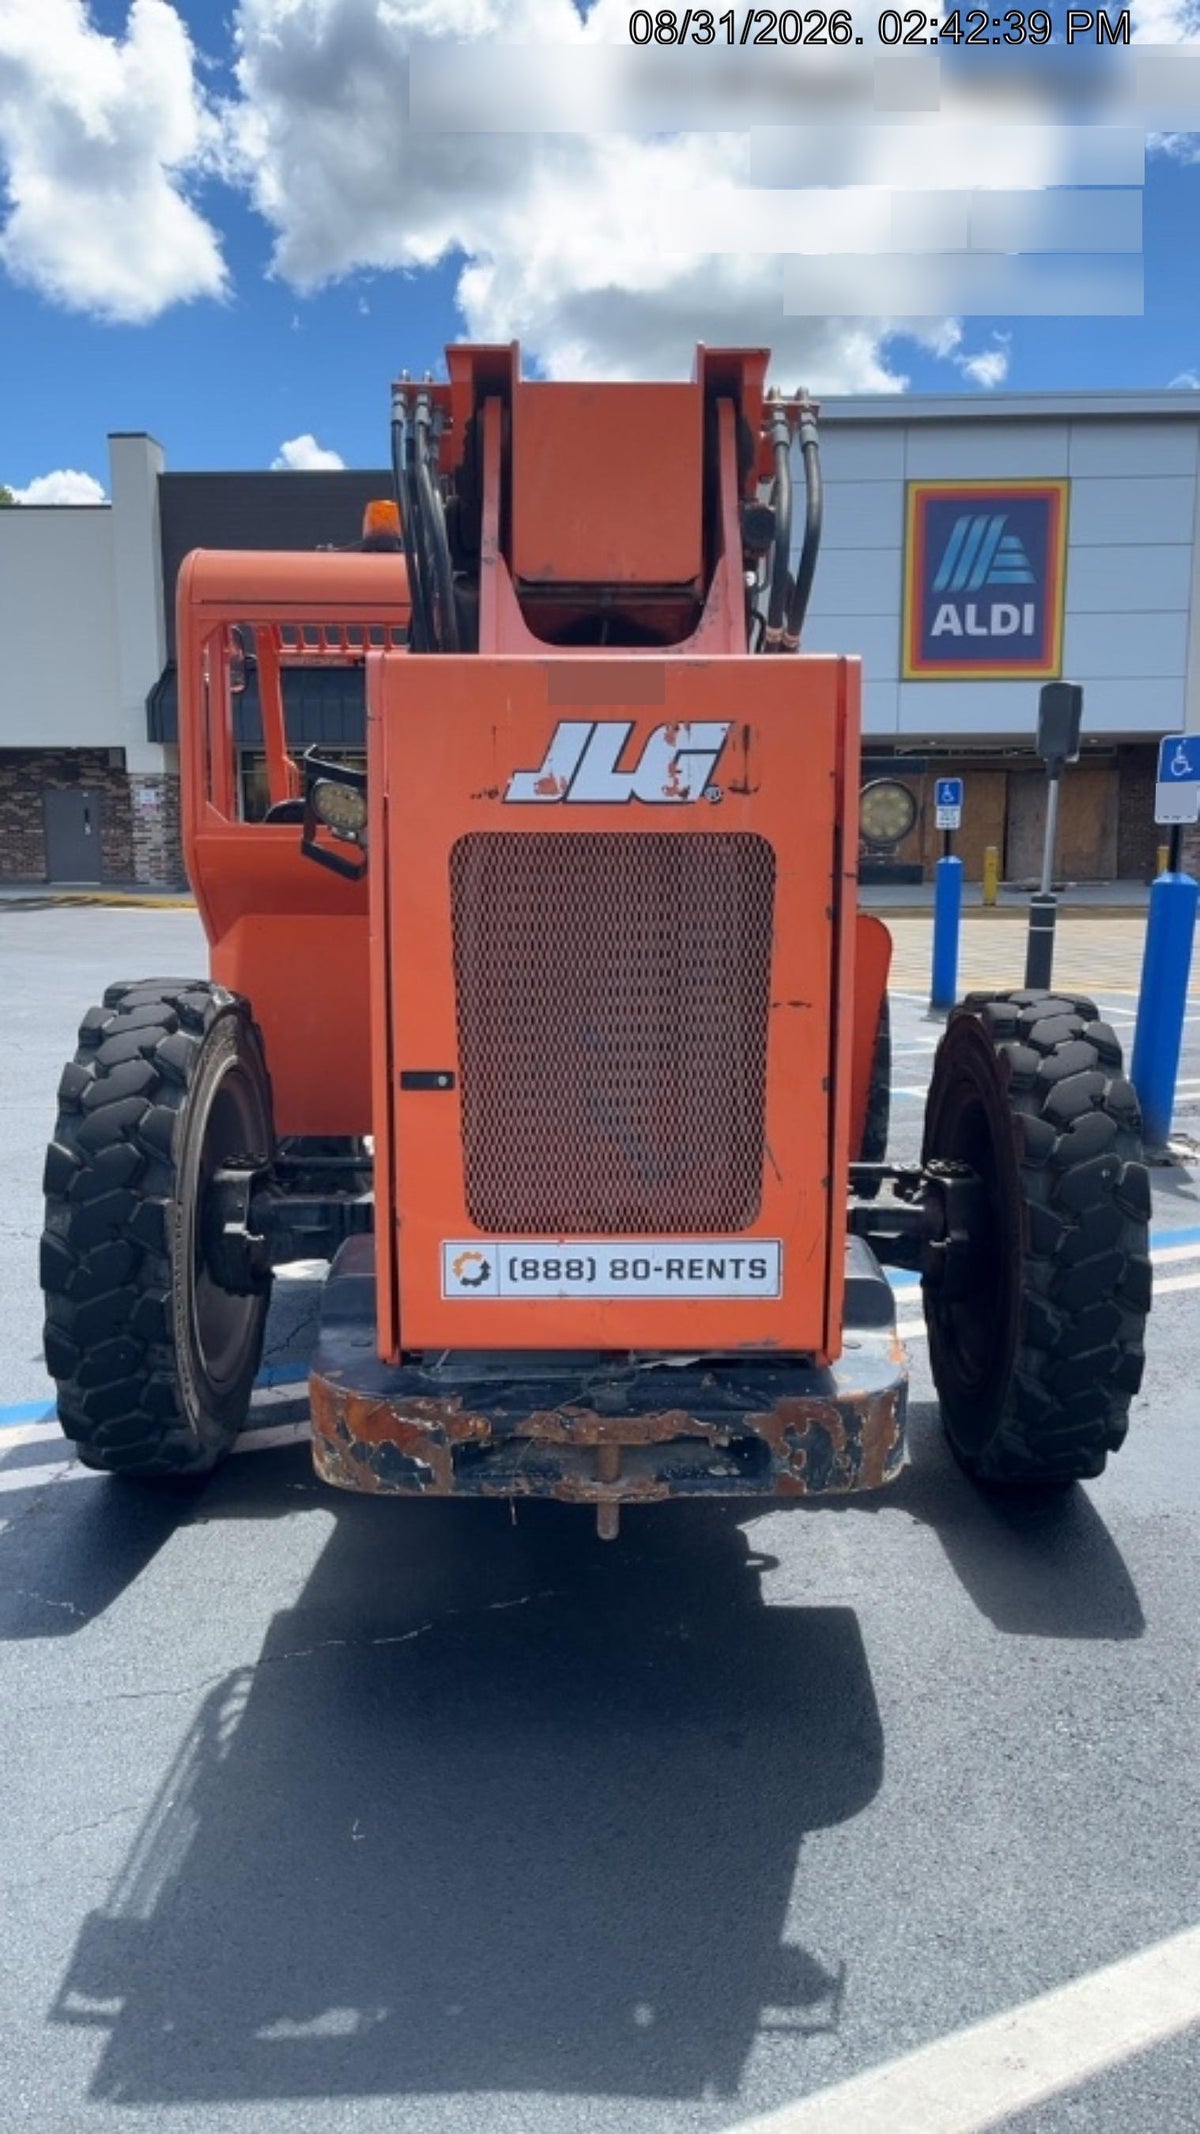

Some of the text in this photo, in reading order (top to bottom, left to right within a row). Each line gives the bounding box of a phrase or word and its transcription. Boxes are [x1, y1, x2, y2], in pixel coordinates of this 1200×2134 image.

[931, 603, 1035, 636] ALDI
[502, 720, 734, 804] JLG
[509, 1257, 768, 1282] (888) 80-RENTS
